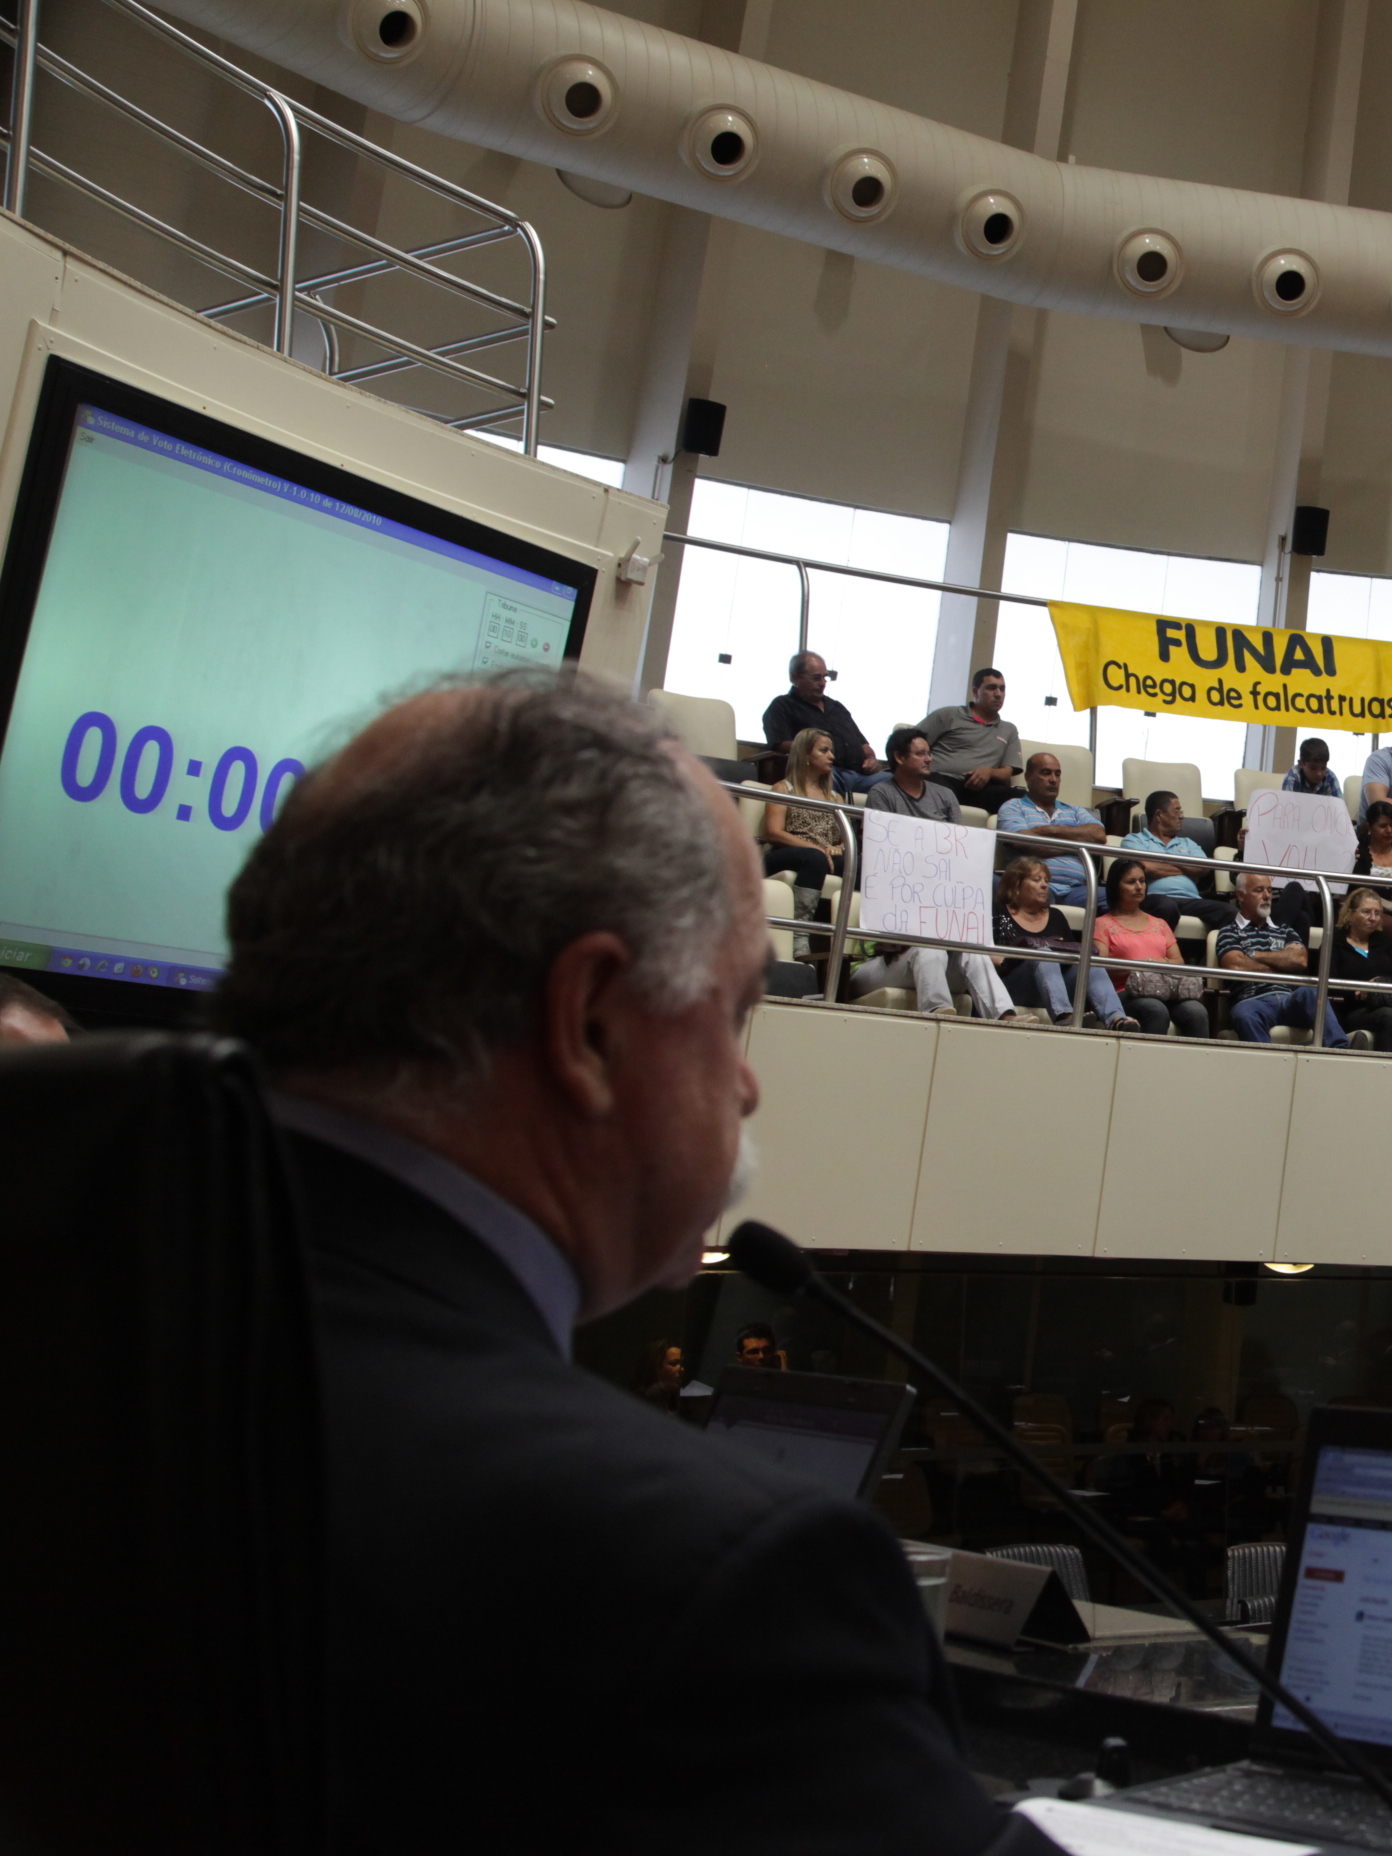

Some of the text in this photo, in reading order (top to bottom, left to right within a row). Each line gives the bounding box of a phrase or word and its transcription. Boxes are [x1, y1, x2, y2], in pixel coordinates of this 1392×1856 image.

[80, 432, 95, 444] Sair
[97, 415, 135, 438] Sistema
[138, 431, 150, 443] de
[152, 434, 173, 451] Voto
[175, 443, 222, 469] Eletrônico
[322, 498, 333, 509] de
[335, 502, 382, 526] 12/08/2010
[519, 621, 528, 631] SS
[1155, 618, 1337, 677] FUNAI
[1102, 660, 1196, 705] Chega
[1206, 677, 1243, 710] de
[1248, 791, 1301, 832] PARA
[866, 810, 969, 859] SE A BR
[874, 847, 915, 876] NÃO
[864, 872, 985, 911] É POR CULPA
[919, 906, 985, 946] FUNAI
